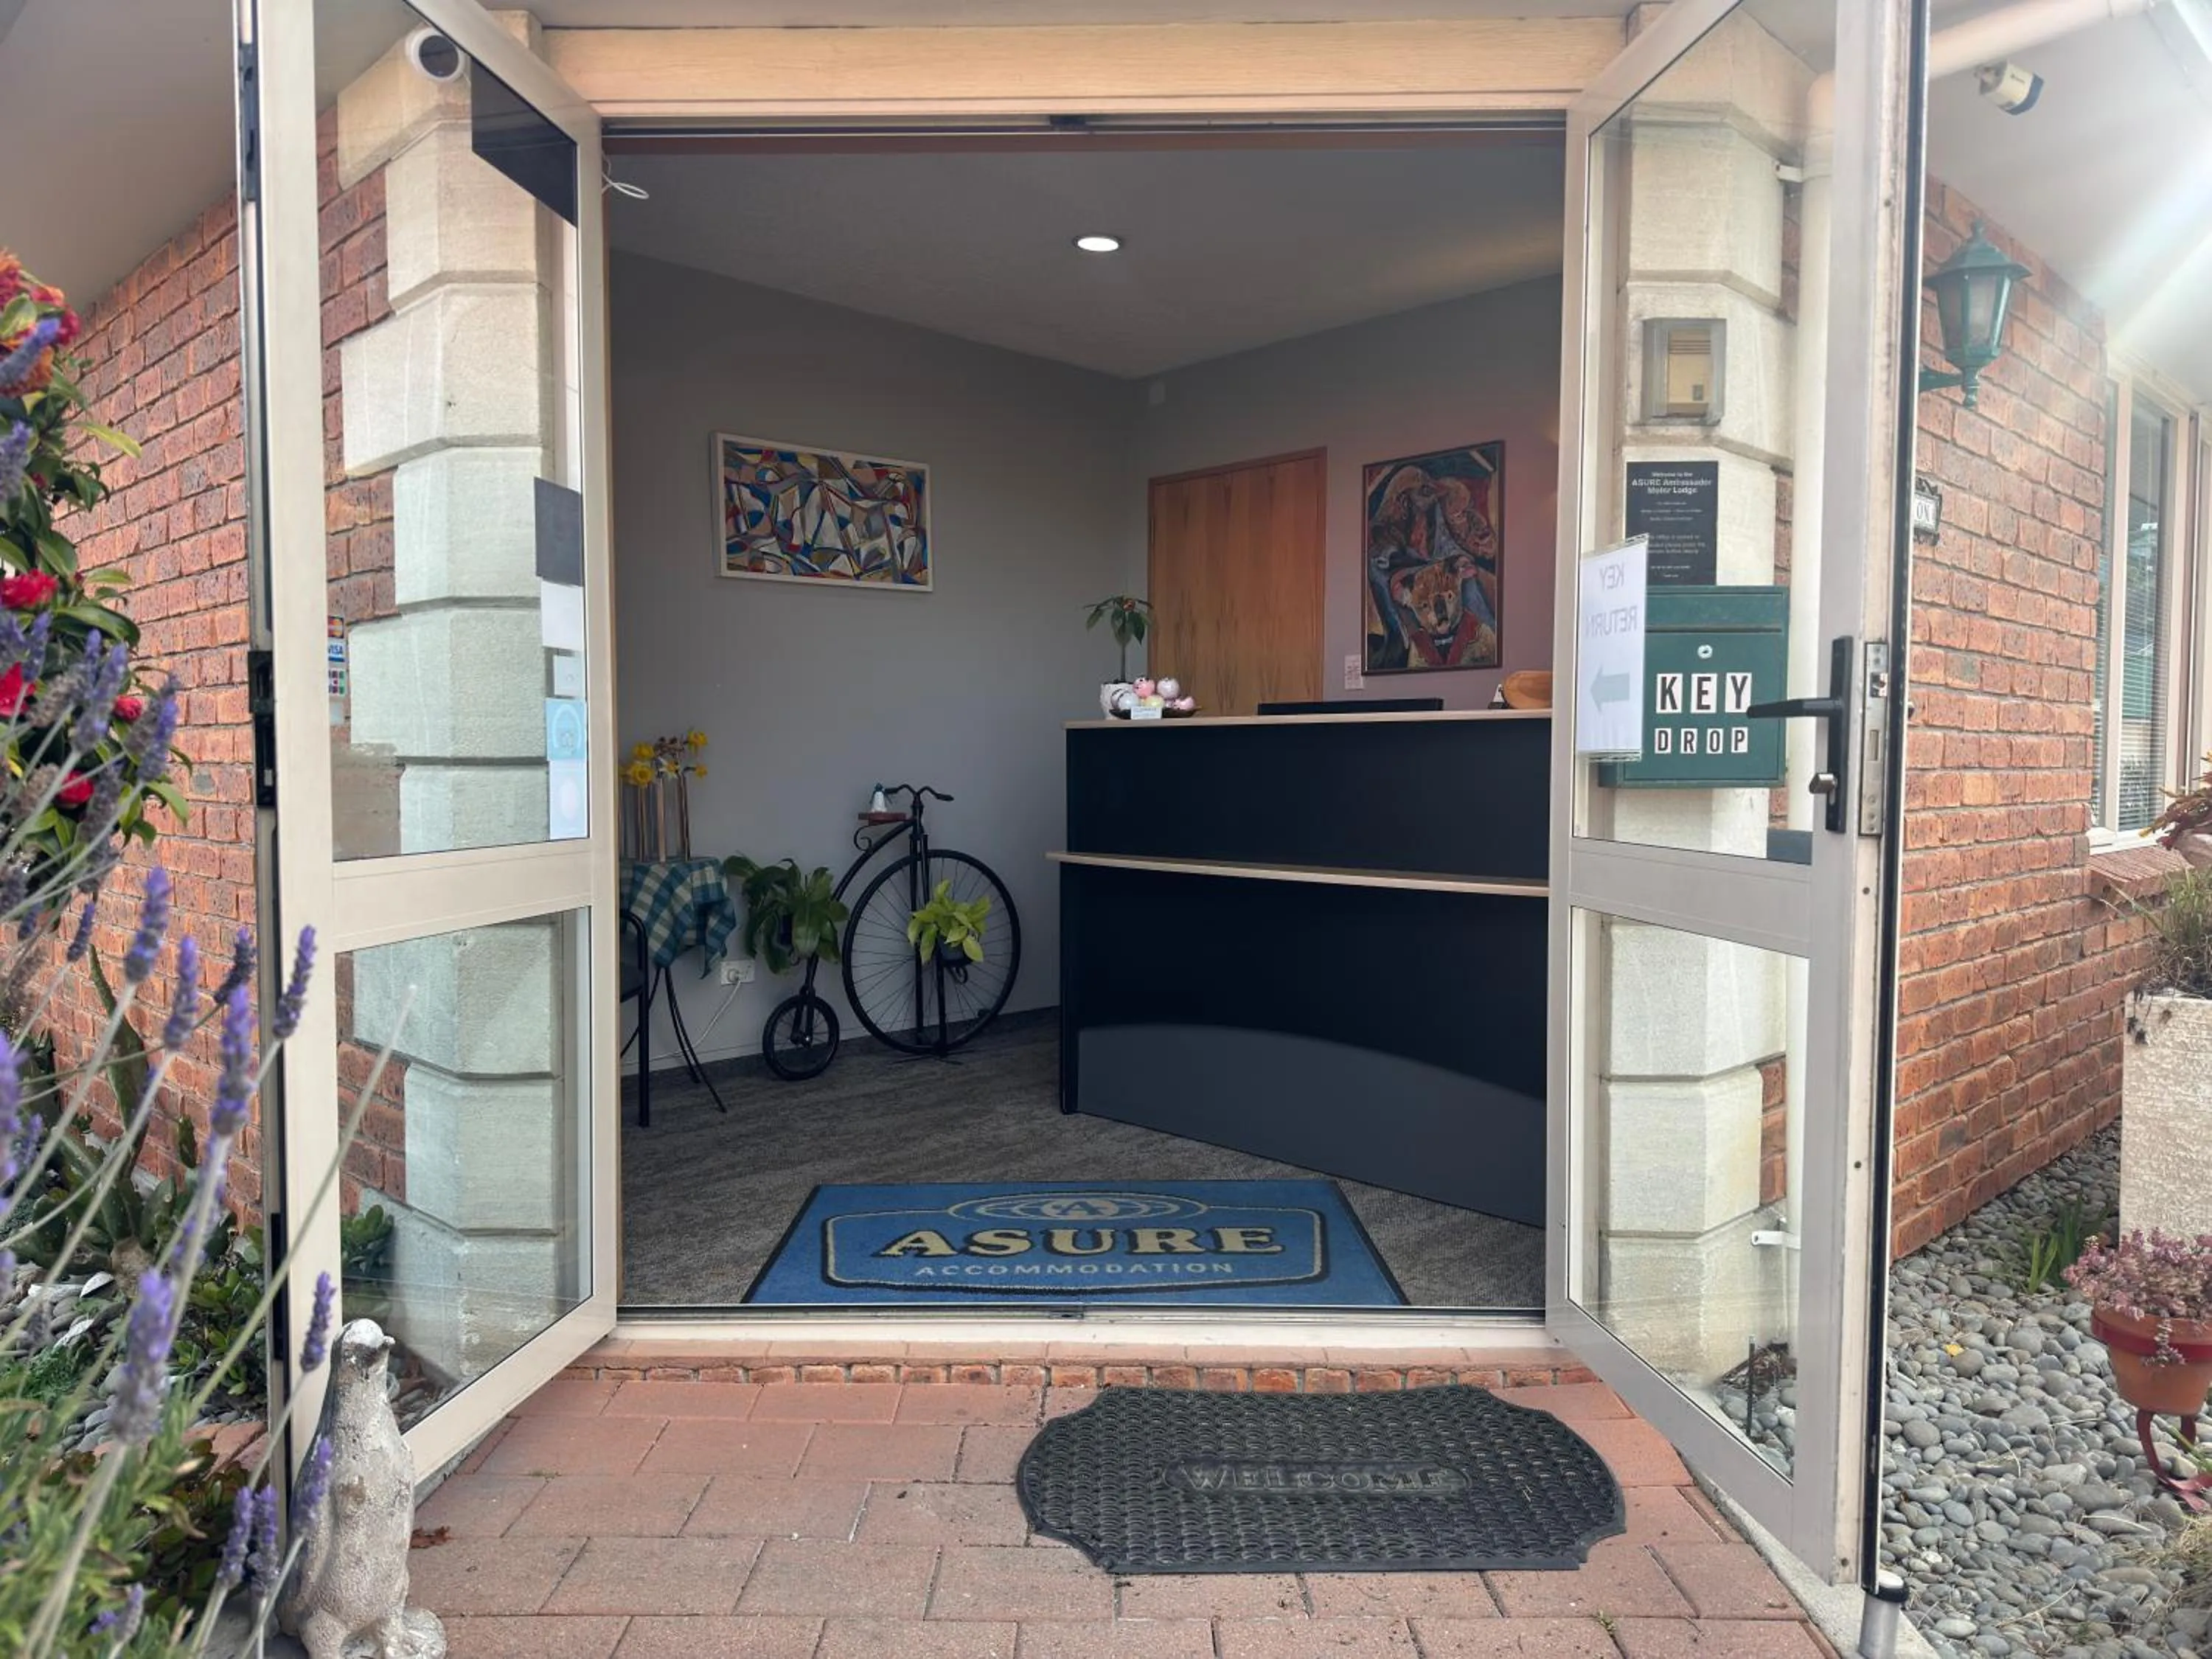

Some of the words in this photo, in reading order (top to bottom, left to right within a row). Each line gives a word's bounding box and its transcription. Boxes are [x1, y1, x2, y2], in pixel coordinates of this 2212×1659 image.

[1631, 478, 1662, 486] ASURE
[1663, 478, 1711, 486] Ambassador
[1673, 486, 1698, 495] Lodge
[1659, 675, 1748, 711] KEY
[1658, 728, 1746, 753] DROP
[880, 1227, 1284, 1256] ASURE
[914, 1262, 1234, 1276] ACCOMMODATION
[1180, 1464, 1445, 1491] WELCOME
